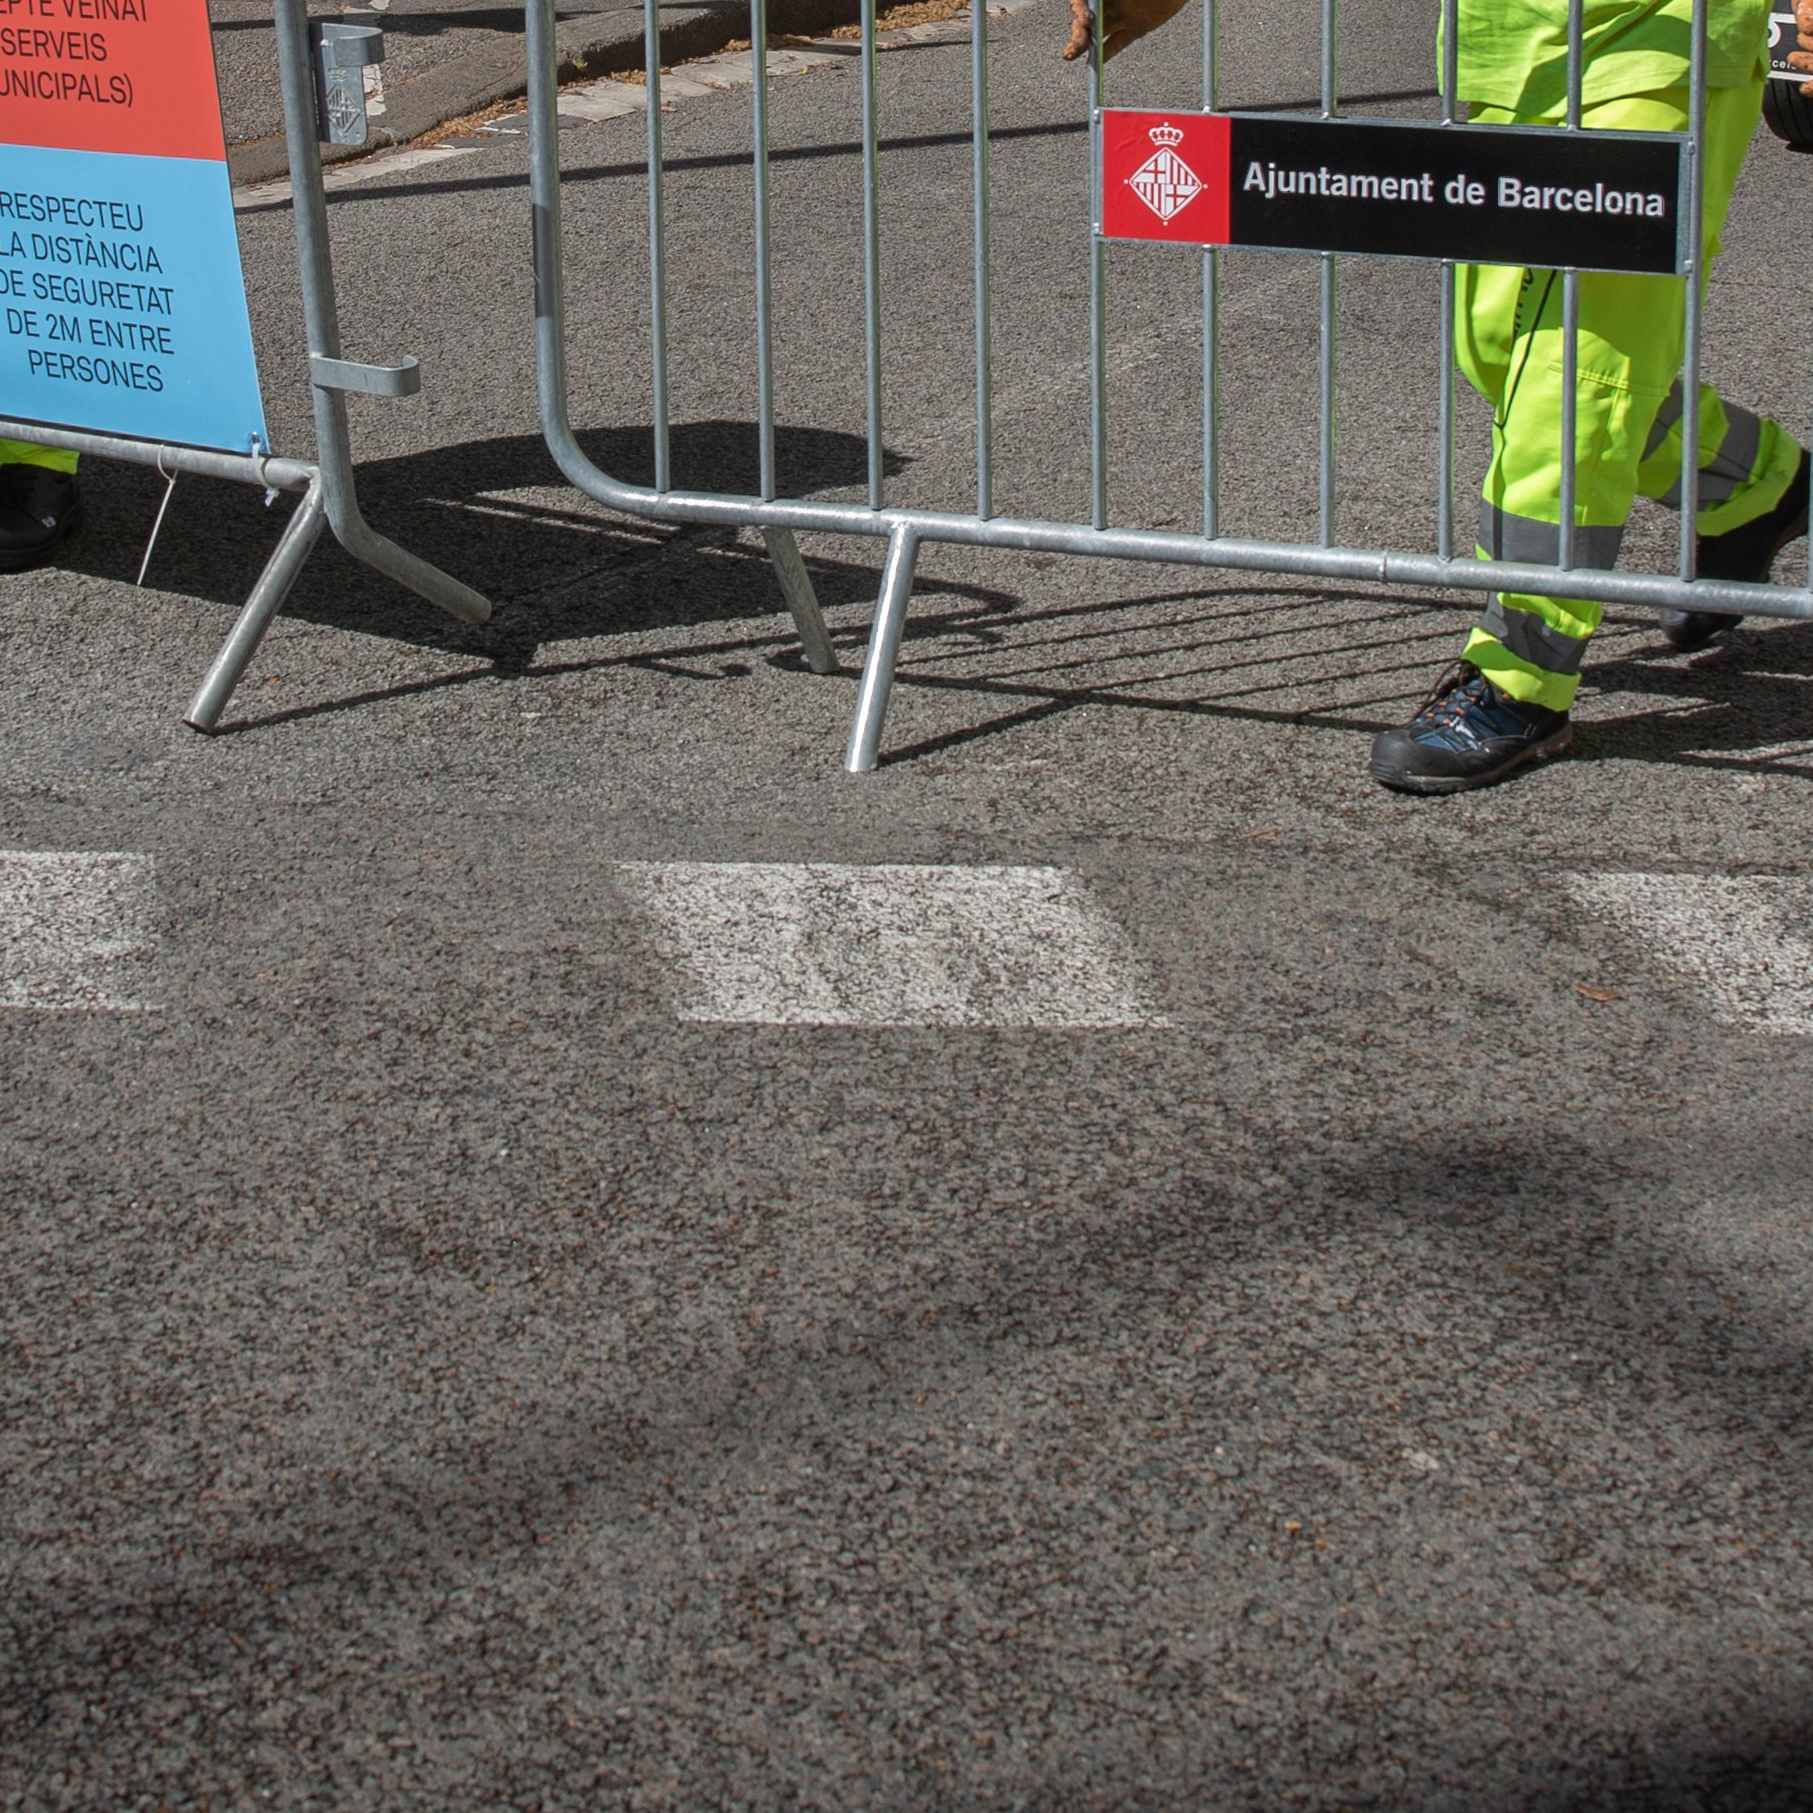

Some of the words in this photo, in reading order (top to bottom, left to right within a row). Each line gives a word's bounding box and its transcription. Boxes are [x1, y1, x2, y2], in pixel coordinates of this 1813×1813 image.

[0, 27, 107, 62] SERVEIS
[1243, 160, 1433, 203] Ajuntament
[1445, 172, 1485, 206] de
[1497, 177, 1665, 218] Barcelona
[31, 232, 163, 274] DISTÀNCIA
[32, 272, 174, 315] SEGURETAT
[6, 308, 40, 337] DE
[46, 313, 82, 343] 2M
[89, 318, 175, 354] ENTRE
[28, 349, 164, 392] PERSONES
